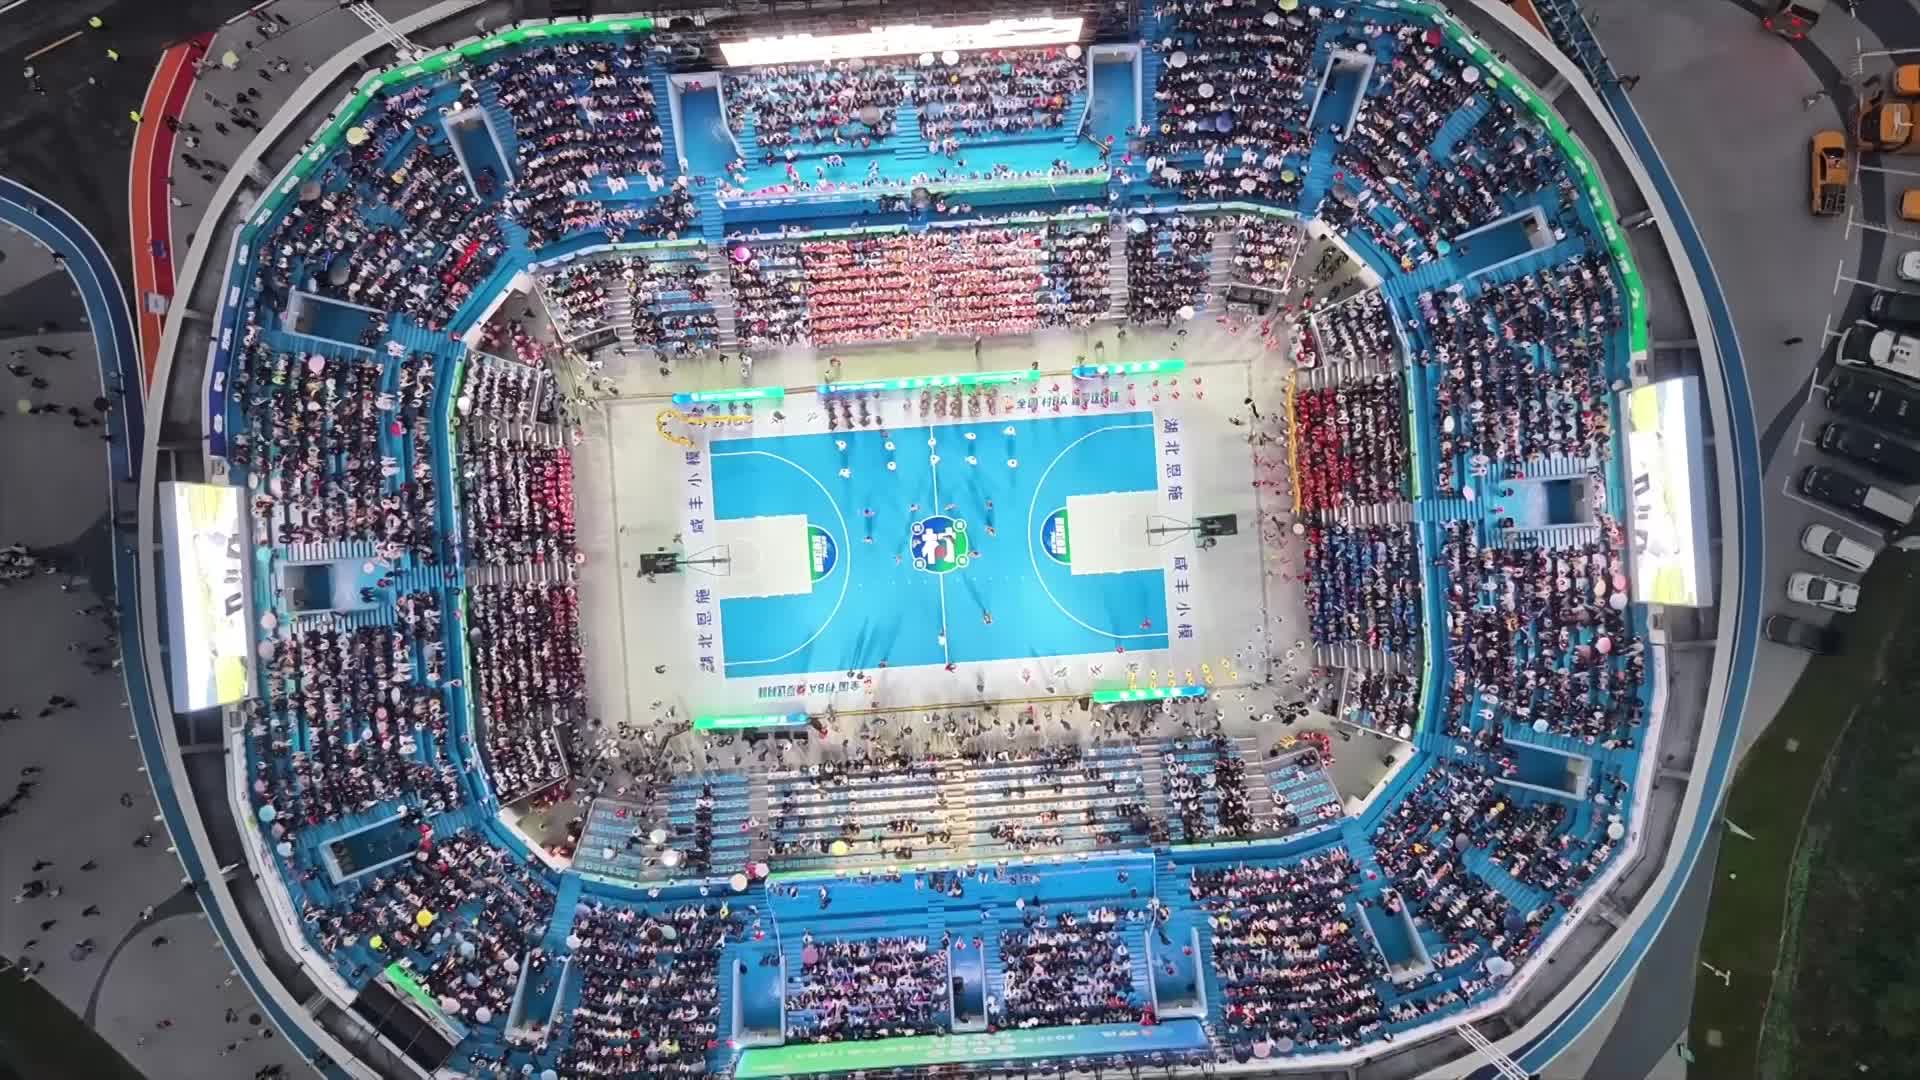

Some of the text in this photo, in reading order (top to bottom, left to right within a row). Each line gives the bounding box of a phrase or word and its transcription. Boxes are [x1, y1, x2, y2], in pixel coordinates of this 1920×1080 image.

[686, 451, 704, 533] 咸丰小模
[1164, 418, 1183, 501] 湖北恩施
[695, 589, 714, 673] 湖北恩施
[1174, 556, 1193, 639] 咸丰小模
